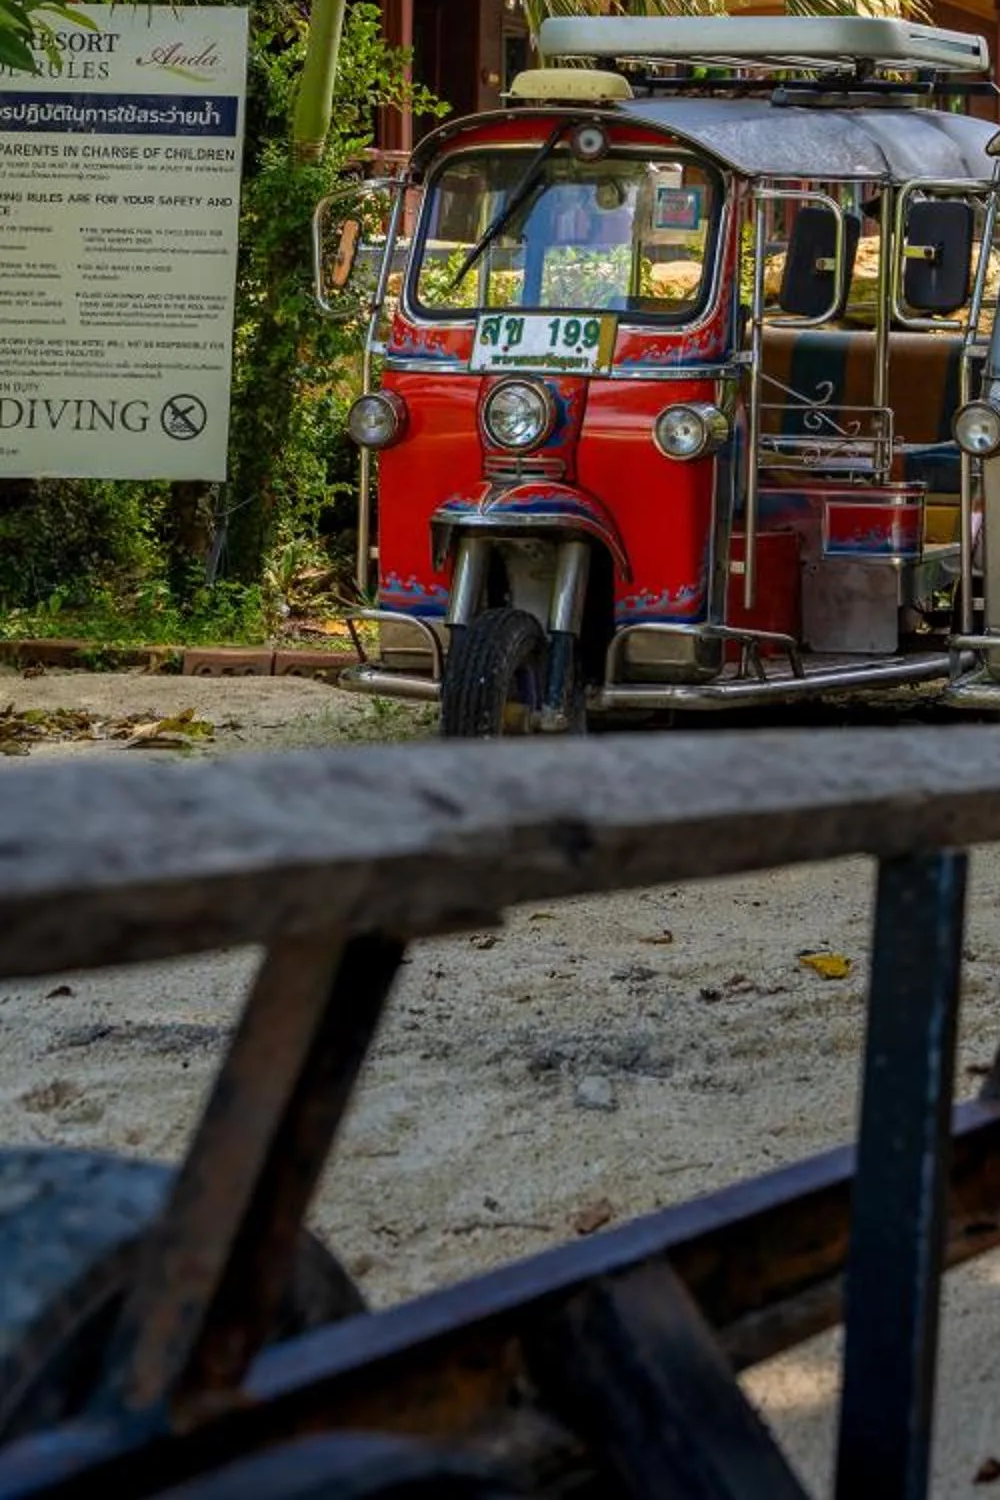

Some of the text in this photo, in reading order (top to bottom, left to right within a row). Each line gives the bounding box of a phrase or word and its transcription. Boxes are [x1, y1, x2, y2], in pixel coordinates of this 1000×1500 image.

[24, 31, 120, 53] SORT
[136, 42, 221, 68] Anda
[63, 145, 78, 157] IN
[81, 145, 139, 159] CHARGE
[143, 147, 161, 159] OF
[164, 147, 235, 161] CHILDREN
[123, 195, 154, 205] YOUR
[159, 195, 202, 206] SAFETY
[207, 197, 232, 207] AND
[548, 317, 601, 349] 199
[0, 397, 150, 433] DIVING
